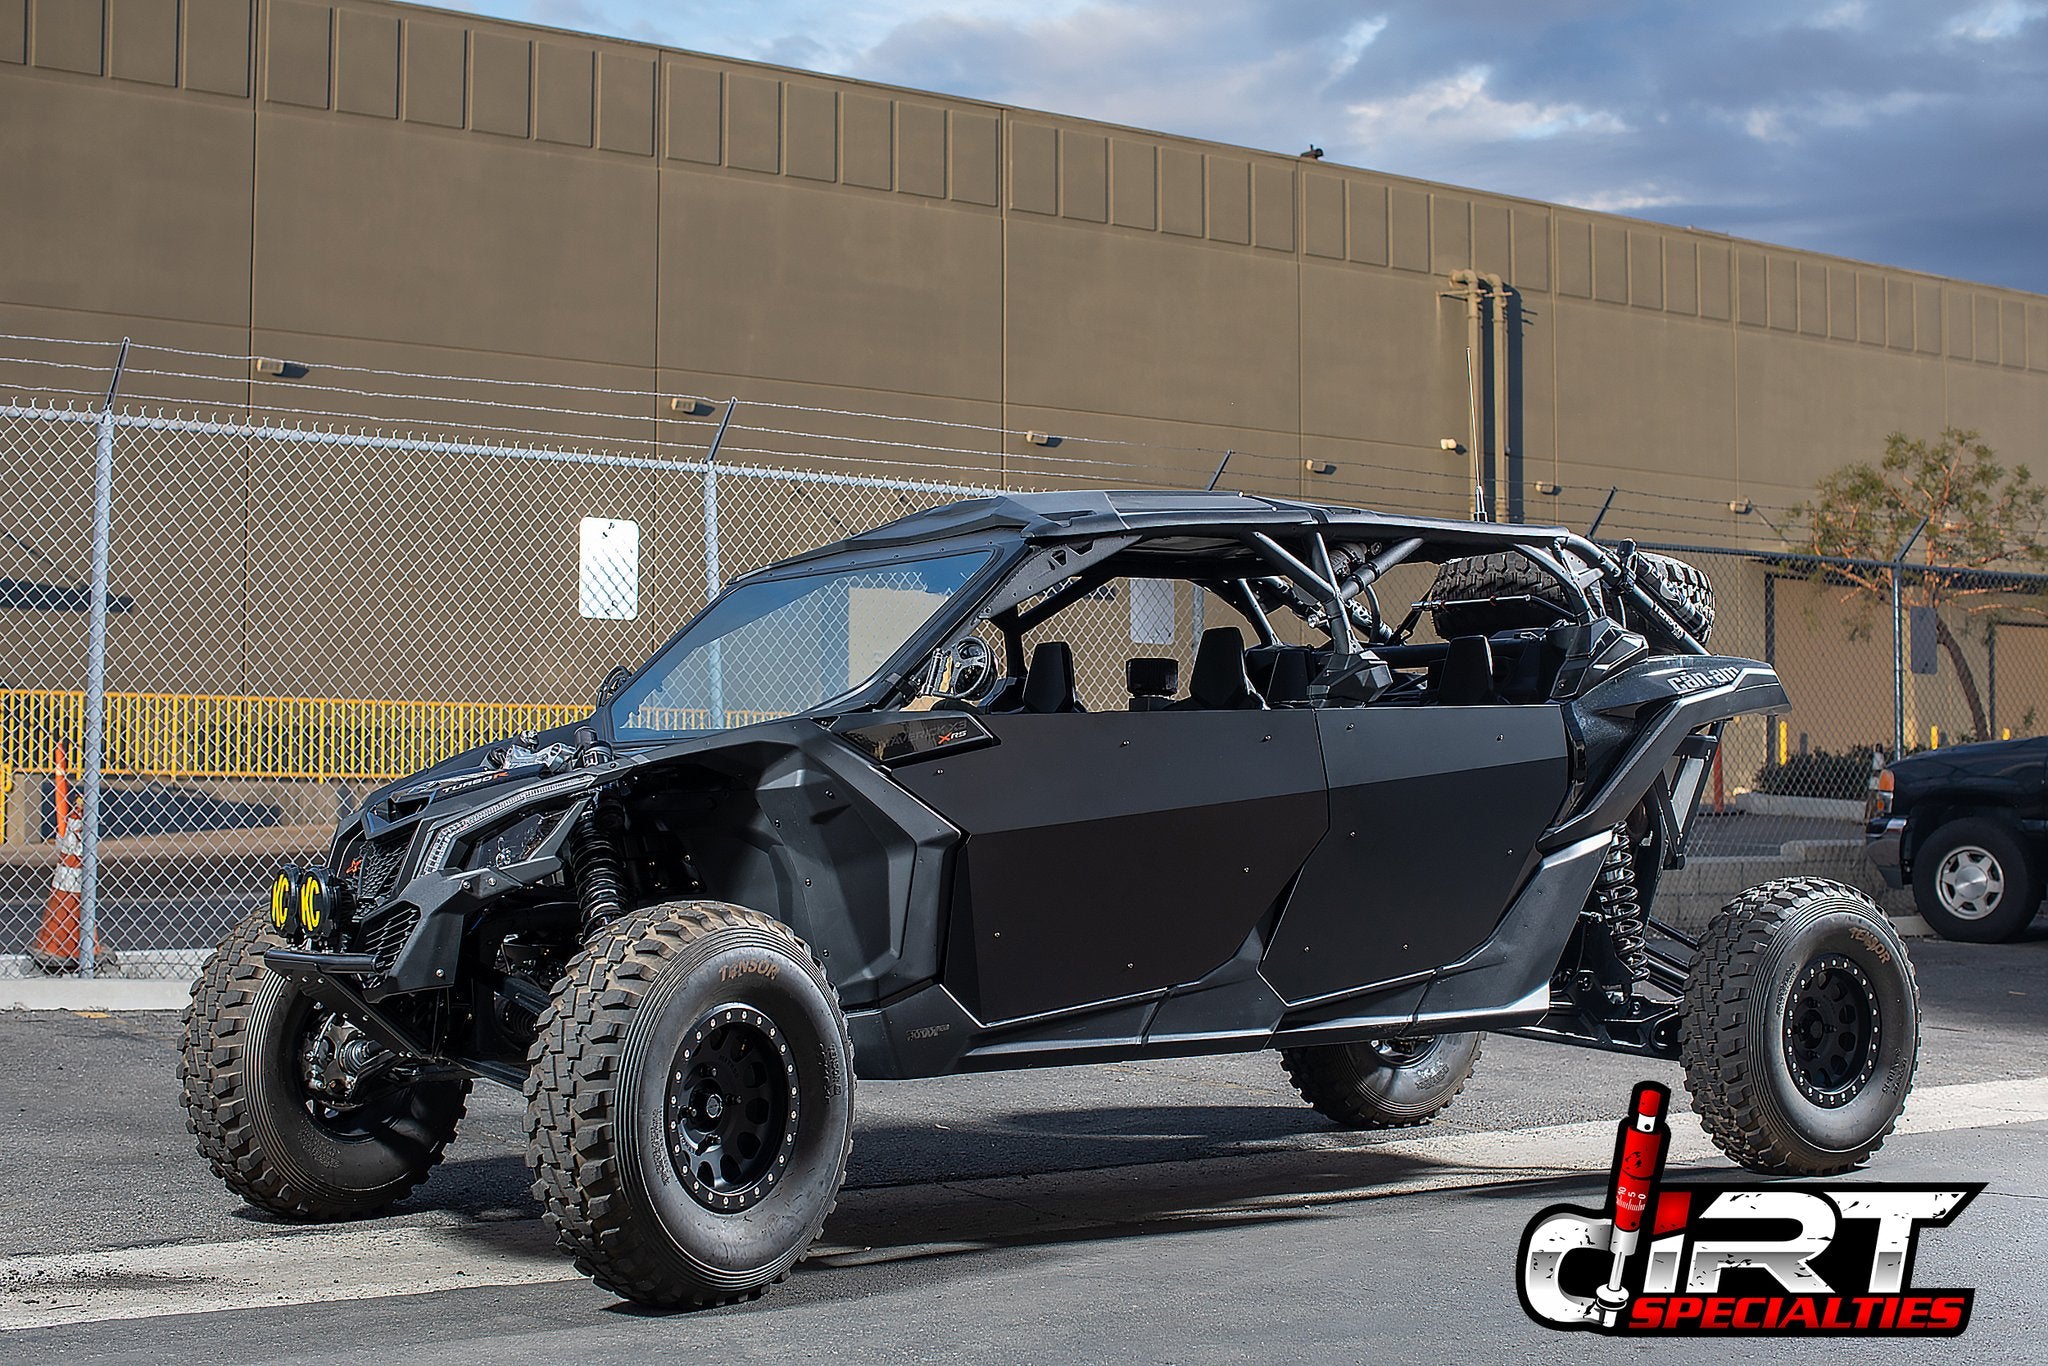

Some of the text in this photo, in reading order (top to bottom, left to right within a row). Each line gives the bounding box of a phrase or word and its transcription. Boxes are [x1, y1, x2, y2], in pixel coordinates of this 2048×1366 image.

[1666, 666, 1740, 693] can-am
[271, 873, 289, 928] KC
[300, 876, 321, 932] KC
